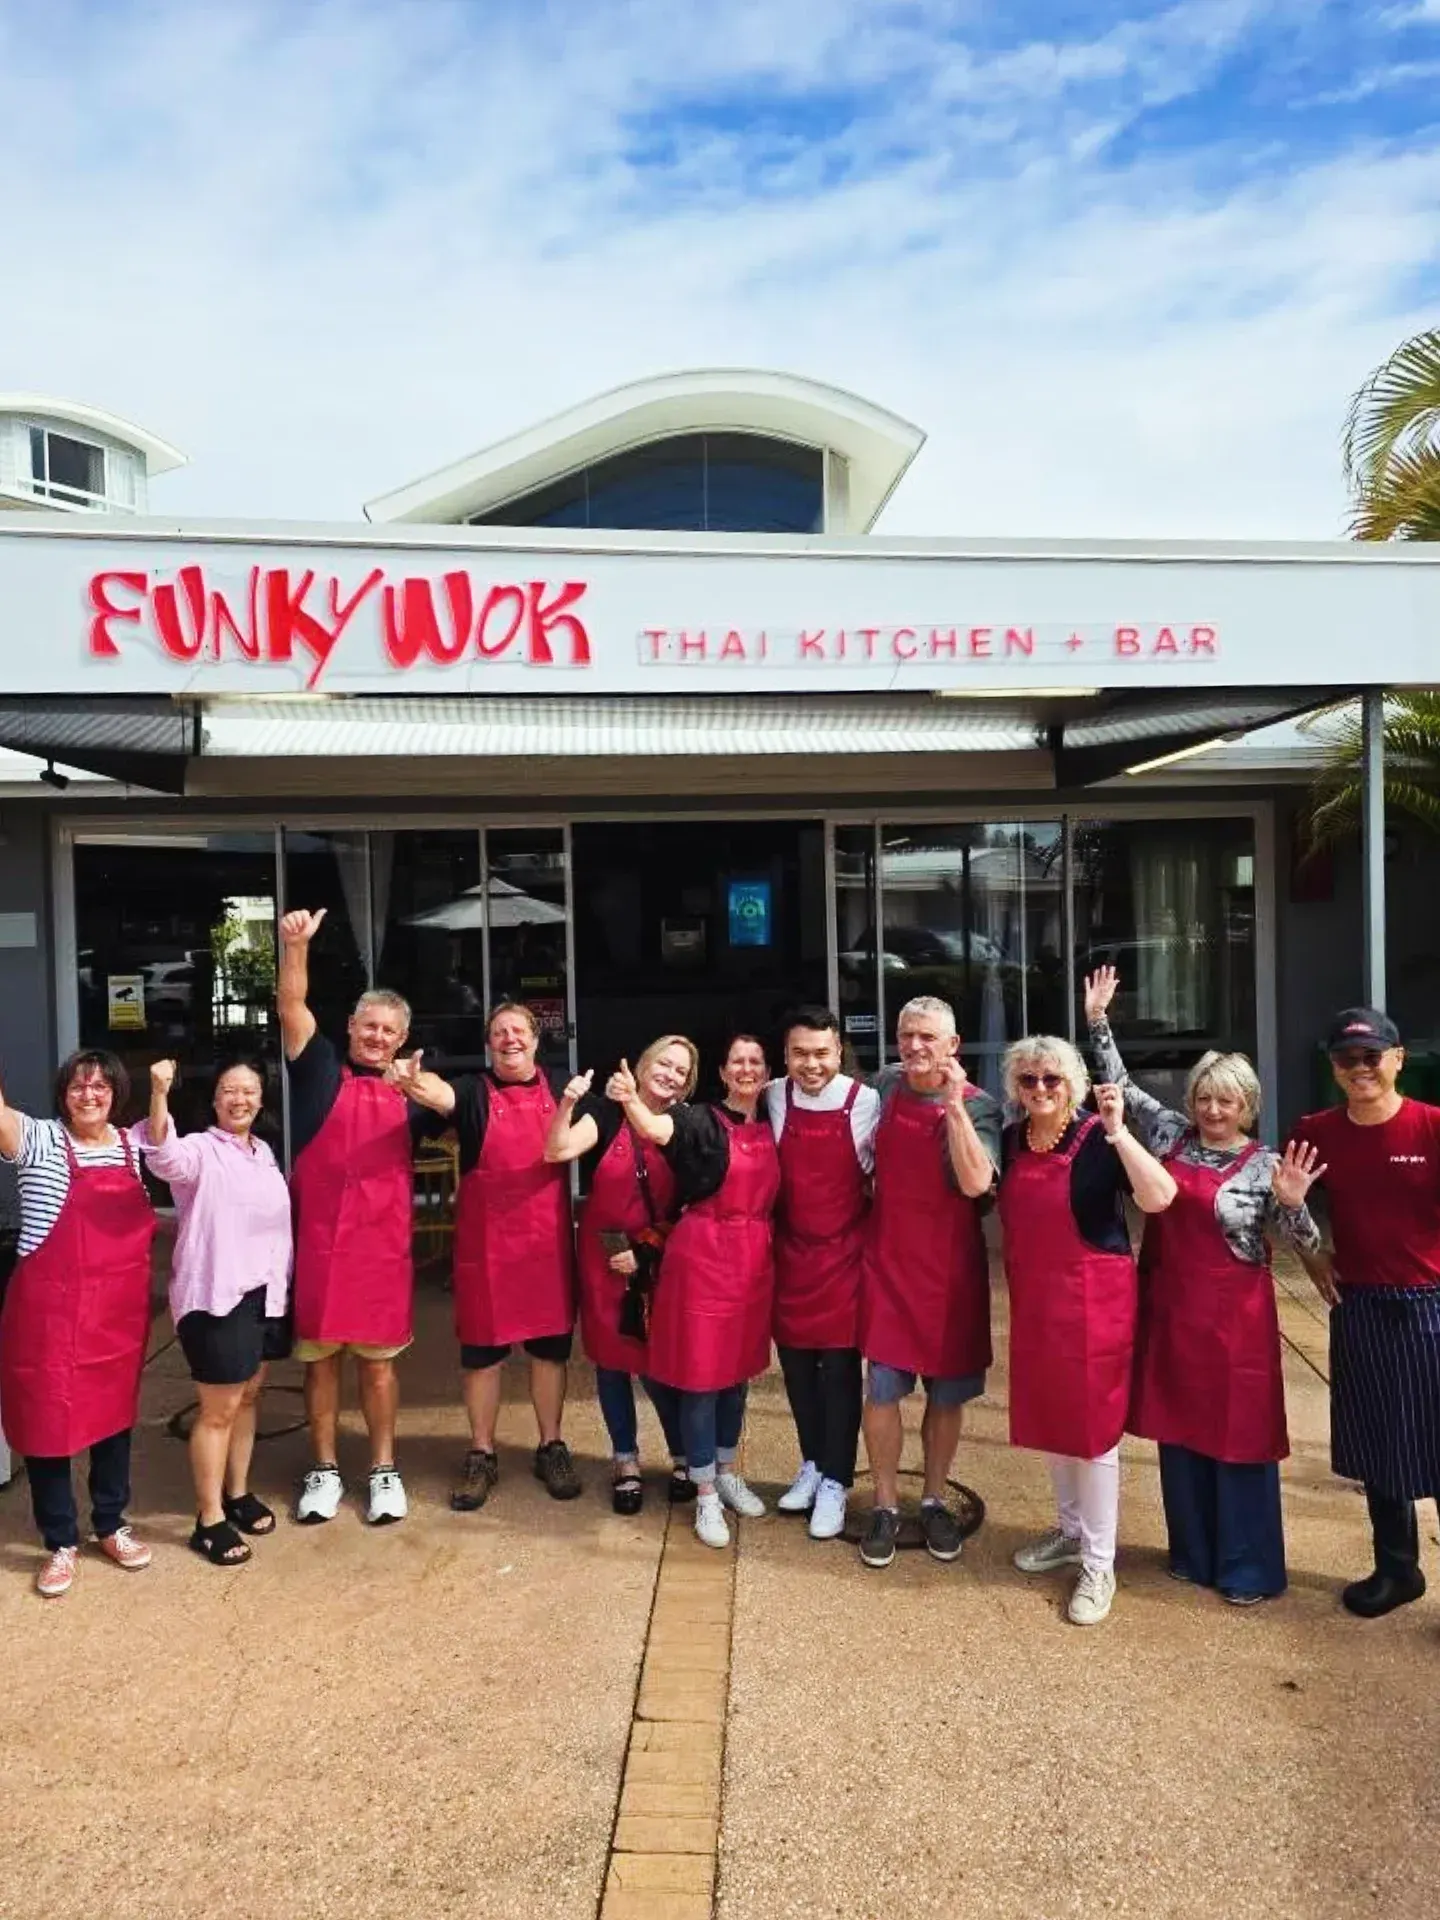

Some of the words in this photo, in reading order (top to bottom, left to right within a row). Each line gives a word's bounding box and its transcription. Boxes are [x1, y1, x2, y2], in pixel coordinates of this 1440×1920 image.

[643, 630, 767, 657] THAI
[800, 628, 1035, 657] KITCHEN
[1116, 626, 1217, 654] BAR
